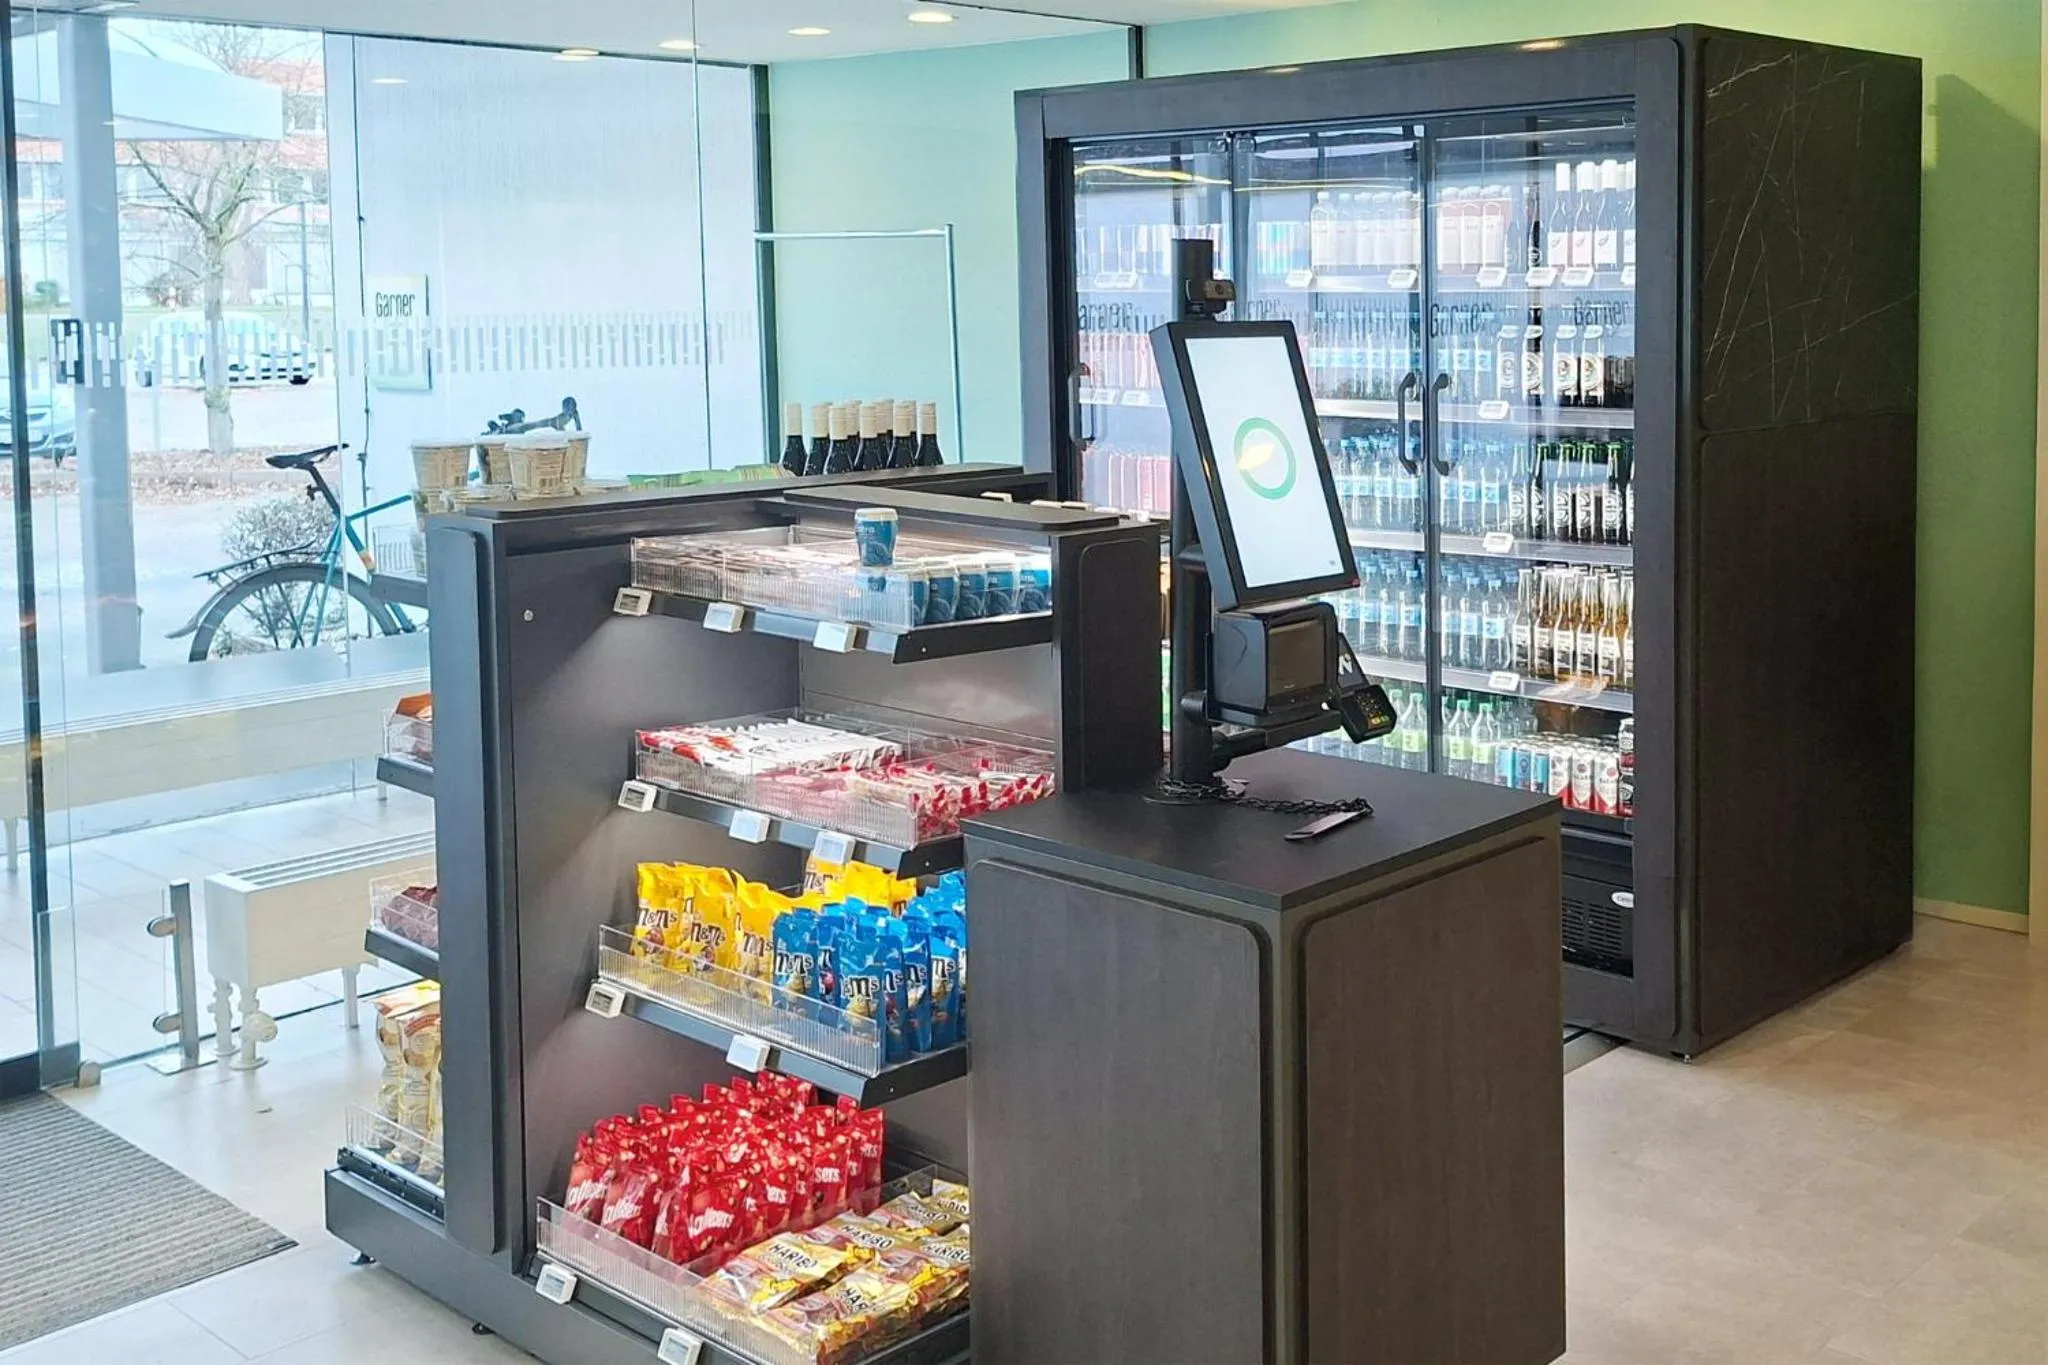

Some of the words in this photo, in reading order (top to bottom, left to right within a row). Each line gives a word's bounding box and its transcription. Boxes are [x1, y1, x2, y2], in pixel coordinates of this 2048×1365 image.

[375, 291, 416, 318] Garner
[842, 1223, 895, 1250] HARIBO
[768, 1241, 819, 1271] HARIBO
